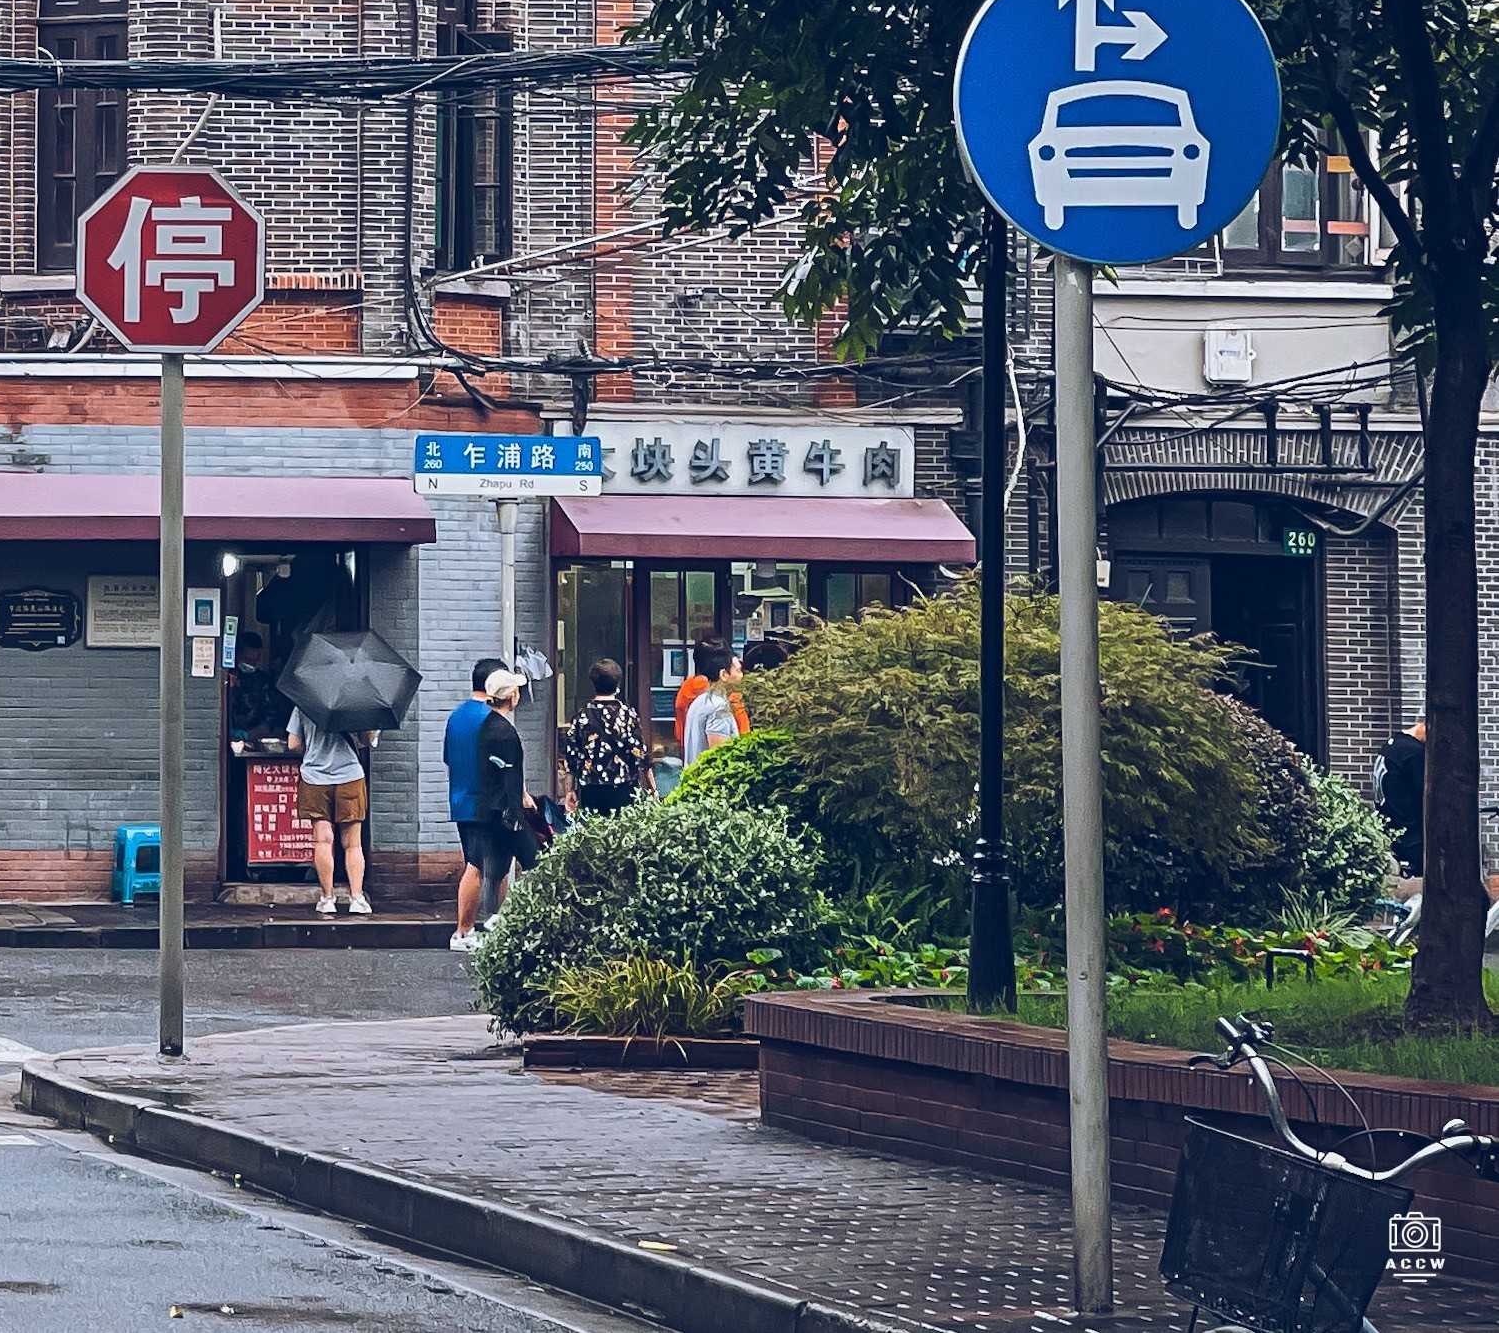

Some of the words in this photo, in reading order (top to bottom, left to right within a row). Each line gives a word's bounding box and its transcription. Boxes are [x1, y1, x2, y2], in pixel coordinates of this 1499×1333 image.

[107, 196, 235, 324] 停
[425, 441, 441, 457] 北
[463, 442, 556, 470] 乍浦路
[577, 443, 593, 459] 南
[423, 459, 443, 469] 260
[428, 478, 438, 489] N
[479, 478, 512, 489] Zhapu
[519, 478, 534, 489] Rd
[579, 480, 588, 492] S
[1288, 531, 1315, 546] 260
